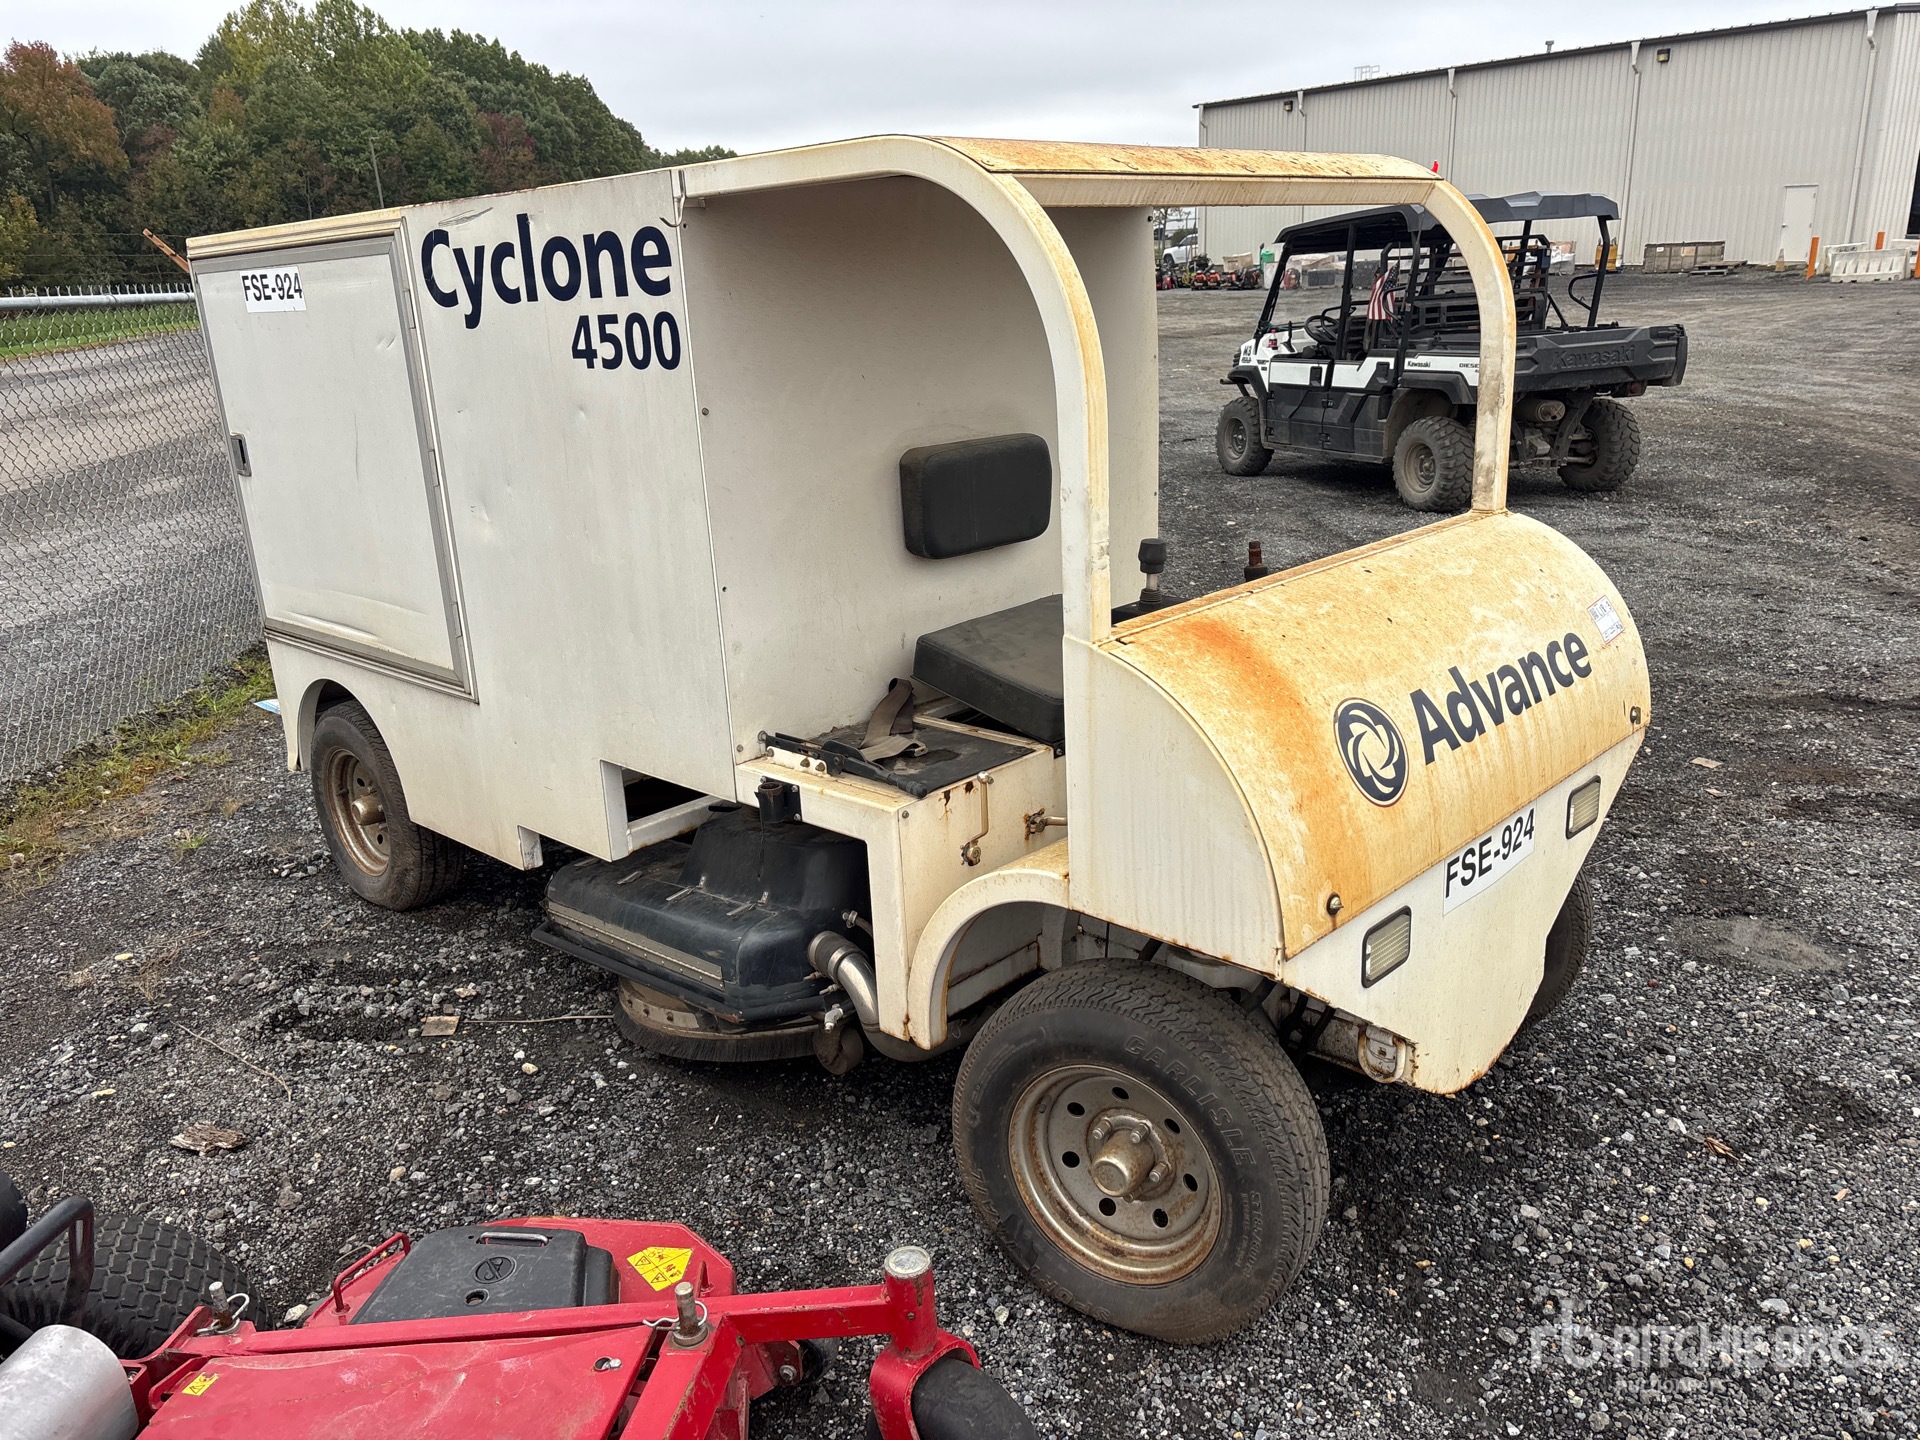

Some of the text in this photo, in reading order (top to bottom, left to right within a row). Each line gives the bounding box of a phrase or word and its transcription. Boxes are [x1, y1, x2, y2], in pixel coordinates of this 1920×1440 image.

[241, 273, 303, 302] FSE-924
[421, 213, 673, 329] Cyclone
[571, 311, 681, 370] 4500
[1407, 360, 1431, 368] Kawasaki
[1552, 344, 1635, 370] Kawasaki
[1409, 632, 1593, 766] Advance
[1445, 808, 1535, 899] FSE-924
[1124, 1034, 1257, 1167] CARLISLE
